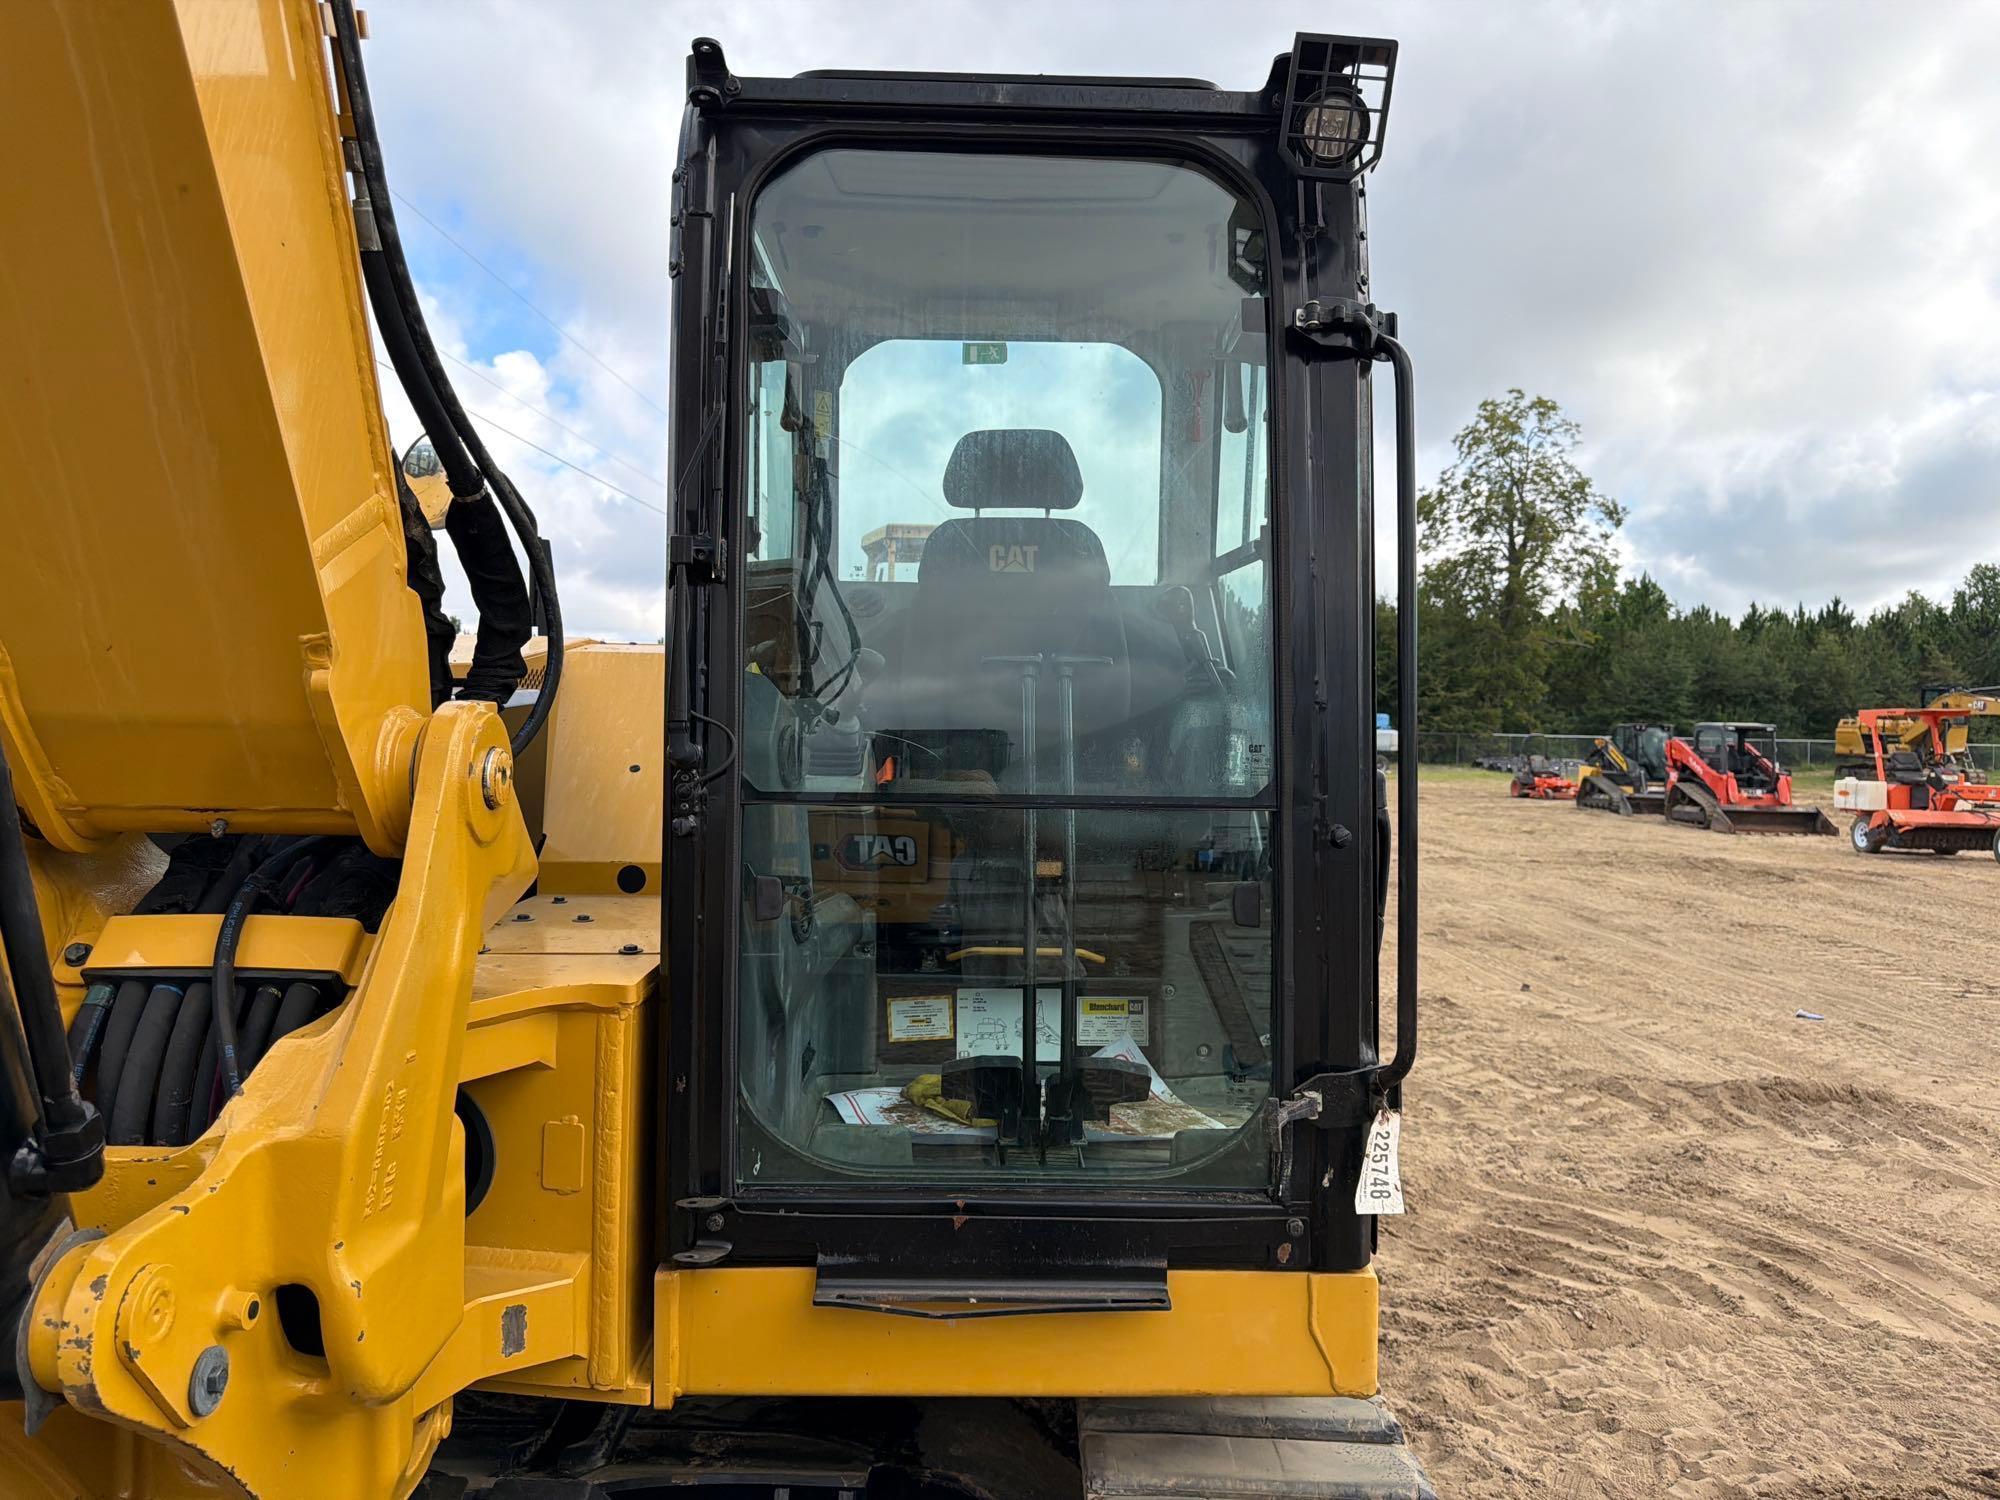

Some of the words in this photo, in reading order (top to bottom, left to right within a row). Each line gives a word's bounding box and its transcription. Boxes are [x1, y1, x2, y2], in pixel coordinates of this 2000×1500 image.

[988, 544, 1039, 573] CAT
[1248, 744, 1262, 753] CAT
[1089, 1003, 1125, 1011] Blanchard
[1370, 1131, 1391, 1200] 225748
